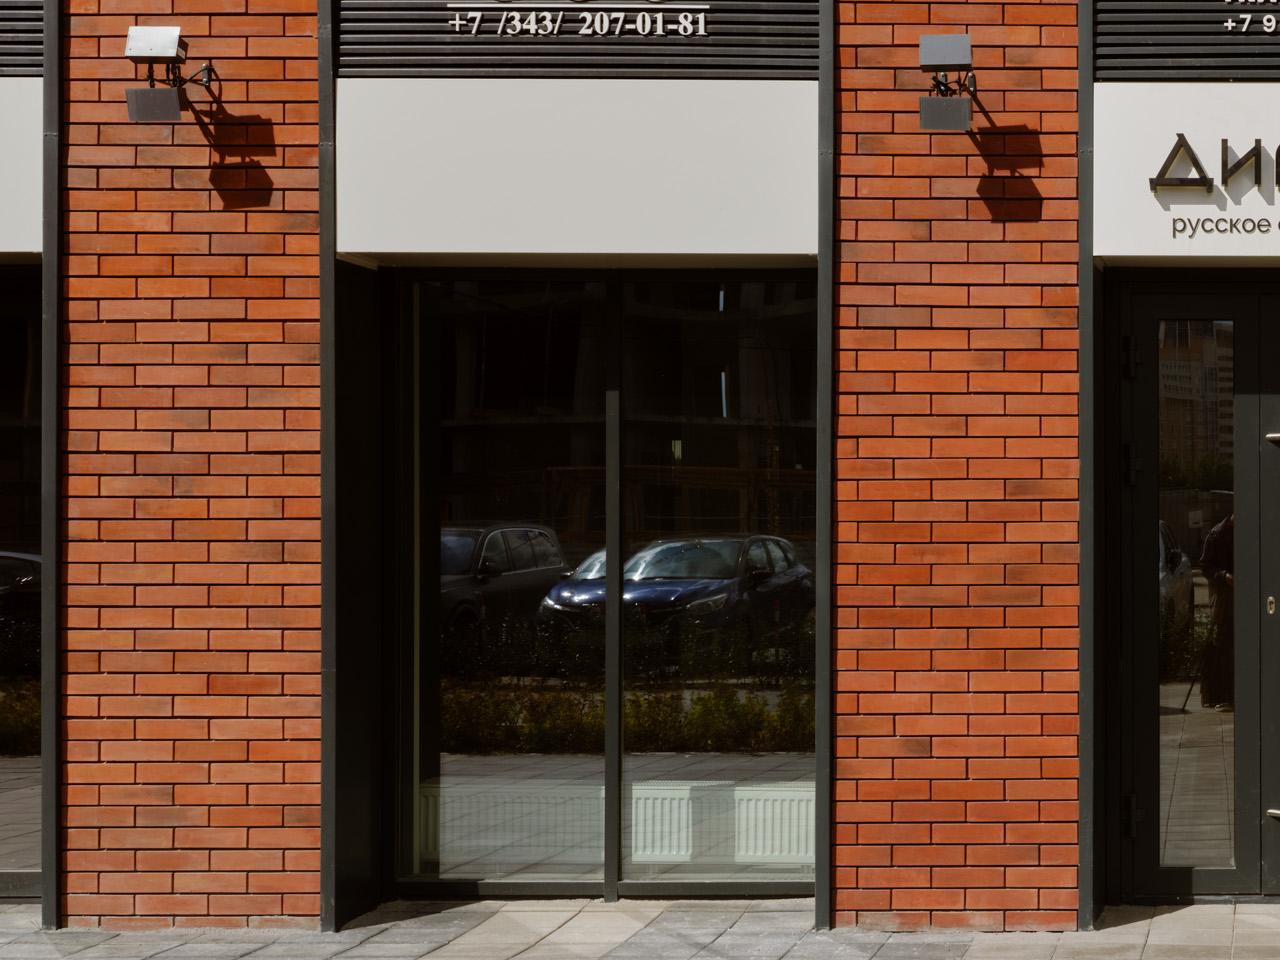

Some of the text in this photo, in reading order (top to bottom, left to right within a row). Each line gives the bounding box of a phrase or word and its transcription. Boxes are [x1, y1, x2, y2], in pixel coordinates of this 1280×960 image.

[448, 12, 708, 36] +7 /343/ 207-01-81
[1223, 13, 1252, 32] +7
[1172, 217, 1271, 240] русское
